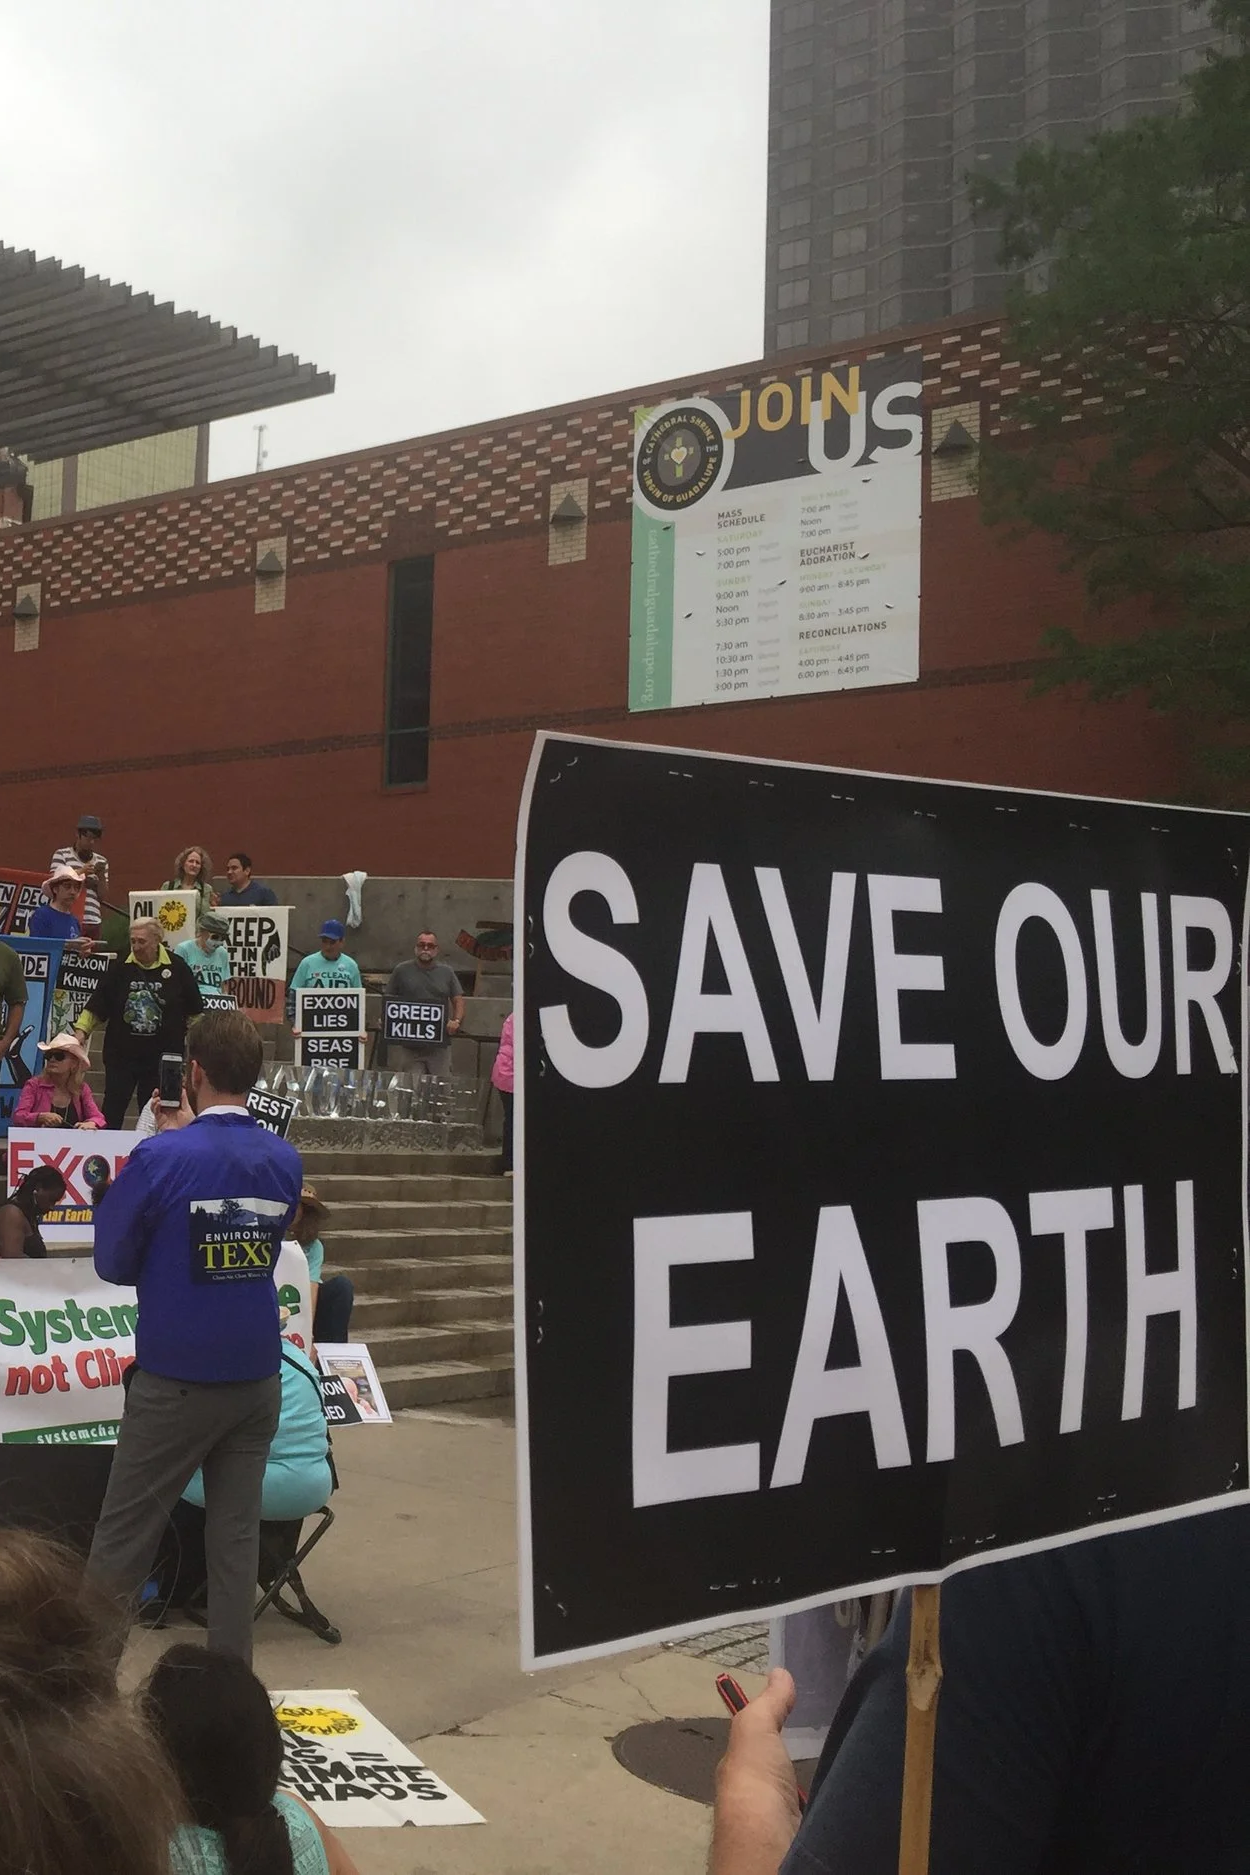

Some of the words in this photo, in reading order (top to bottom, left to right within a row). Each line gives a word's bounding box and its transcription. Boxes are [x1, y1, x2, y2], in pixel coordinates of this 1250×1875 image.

[724, 366, 860, 439] JOIN
[646, 415, 687, 453] CATHEDRAL
[690, 416, 715, 441] SHRINE
[808, 381, 922, 474] US
[676, 458, 717, 502] GUADALUPE
[717, 513, 766, 529] SCHEDULE
[718, 508, 743, 520] MASS
[800, 518, 822, 526] Noon
[717, 547, 735, 557] 5:00
[736, 546, 751, 556] pm
[800, 541, 855, 557] EUCHARIST
[717, 560, 735, 570] 7:00
[735, 559, 750, 568] pm
[799, 551, 856, 566] ADORATION
[715, 591, 734, 600] 9:00
[735, 590, 749, 598] am
[715, 605, 739, 614] Noon
[856, 605, 870, 614] pm
[715, 617, 734, 627] 5:30
[734, 616, 750, 626] pm
[799, 621, 887, 640] RECONCILIATIONS
[715, 641, 734, 651] 7:30
[734, 641, 749, 649] am
[715, 655, 738, 664] 10:30
[739, 654, 753, 662] am
[856, 652, 870, 662] pm
[715, 668, 733, 678] 1:30
[734, 668, 749, 677] pm
[856, 664, 870, 674] pm
[714, 682, 732, 692] 3:00
[733, 681, 749, 691] pm
[20, 888, 52, 906] DEC
[227, 947, 237, 960] T
[241, 947, 257, 962] IN
[22, 954, 47, 977] IDE
[229, 962, 257, 976] THE
[539, 850, 958, 1089] SAVE
[993, 881, 1239, 1082] OUR
[321, 972, 350, 980] CLEAN
[130, 981, 162, 991] STOP
[228, 978, 276, 1009] ROUND
[303, 996, 358, 1010] EXXON
[387, 1003, 442, 1021] GREED
[313, 1014, 348, 1027] LIES
[391, 1022, 436, 1039] KILLS
[307, 1039, 353, 1053] SEAS
[311, 1058, 350, 1069] RISE
[246, 1092, 291, 1120] REST
[64, 1209, 93, 1222] Earth
[632, 1180, 1198, 1508] EARTH
[5, 1355, 70, 1396] not
[325, 1405, 346, 1420] IED
[37, 1424, 121, 1444] systemcha
[279, 1761, 434, 1783] LIMATE
[286, 1783, 447, 1801] HAOS
